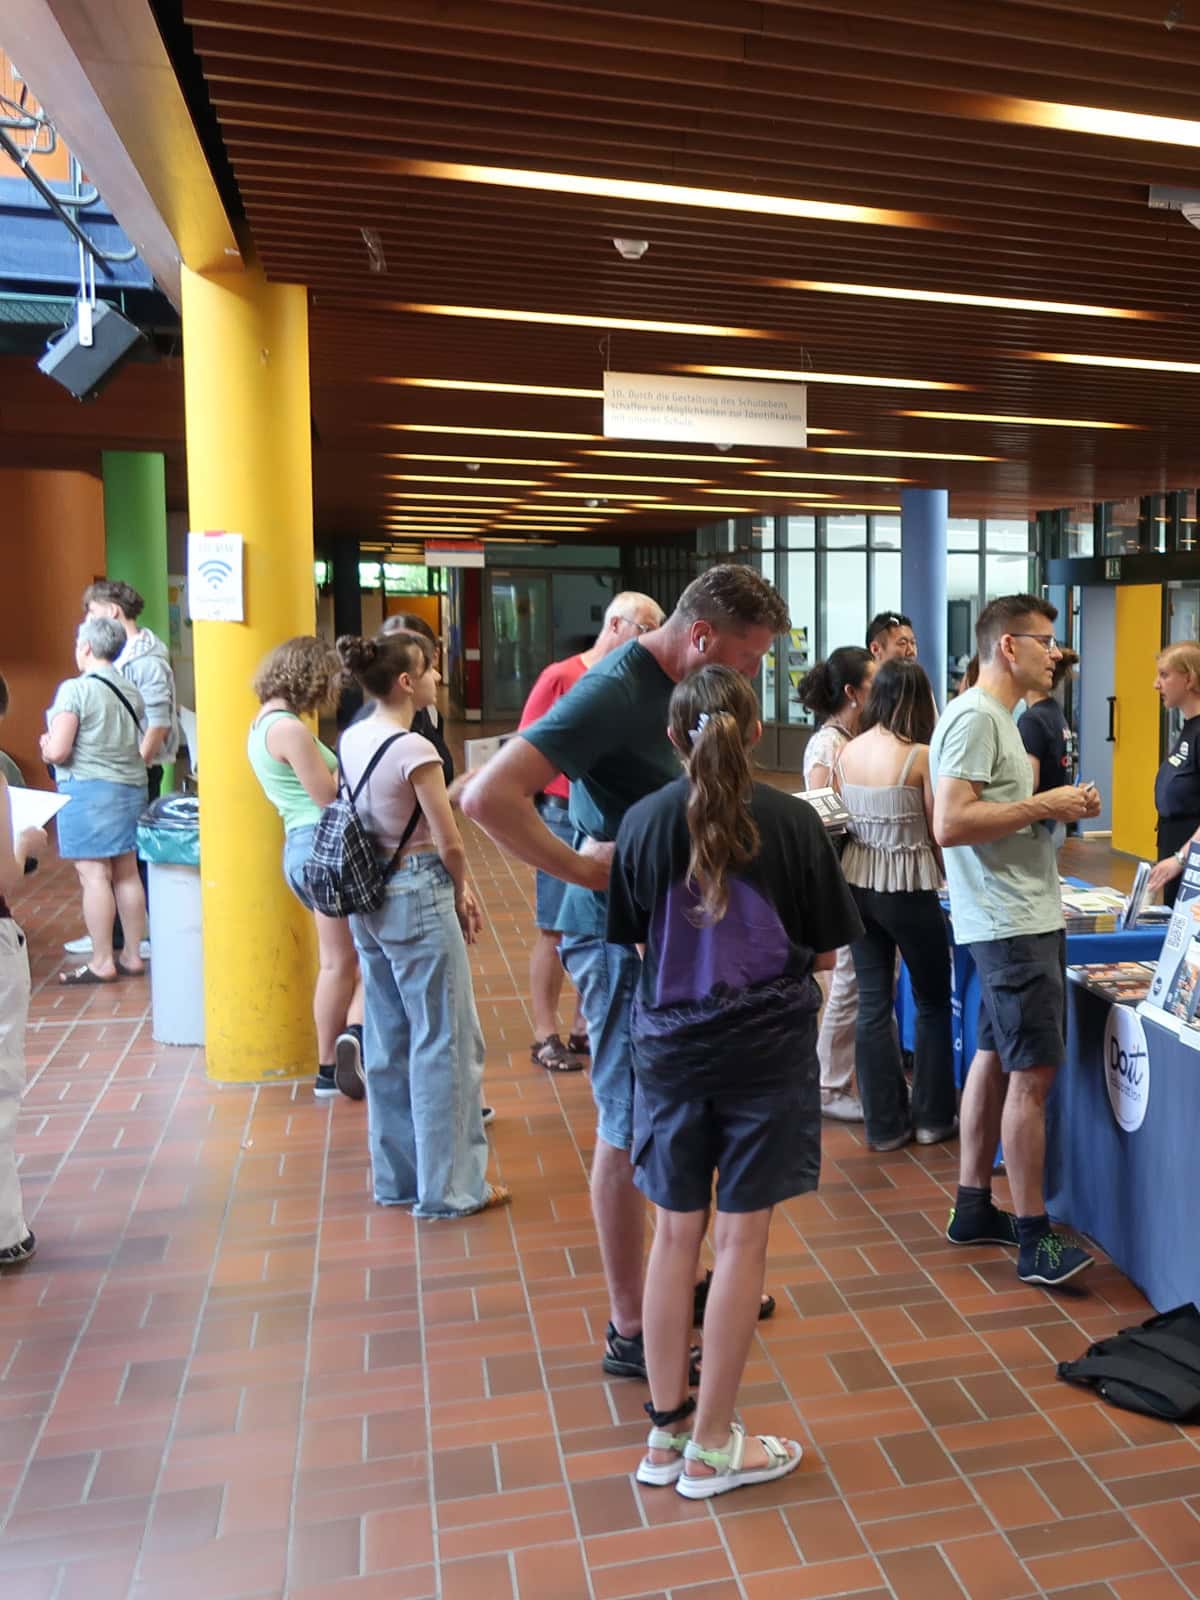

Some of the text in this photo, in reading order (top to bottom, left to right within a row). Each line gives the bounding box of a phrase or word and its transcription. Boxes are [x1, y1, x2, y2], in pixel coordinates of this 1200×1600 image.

[628, 389, 653, 400] Durch
[656, 391, 670, 401] die
[672, 392, 718, 406] Gestaltung
[721, 396, 736, 406] des
[611, 402, 648, 411] schaffen
[650, 403, 664, 412] wir
[666, 404, 727, 416] Möglichkeiten
[729, 409, 743, 418] zur
